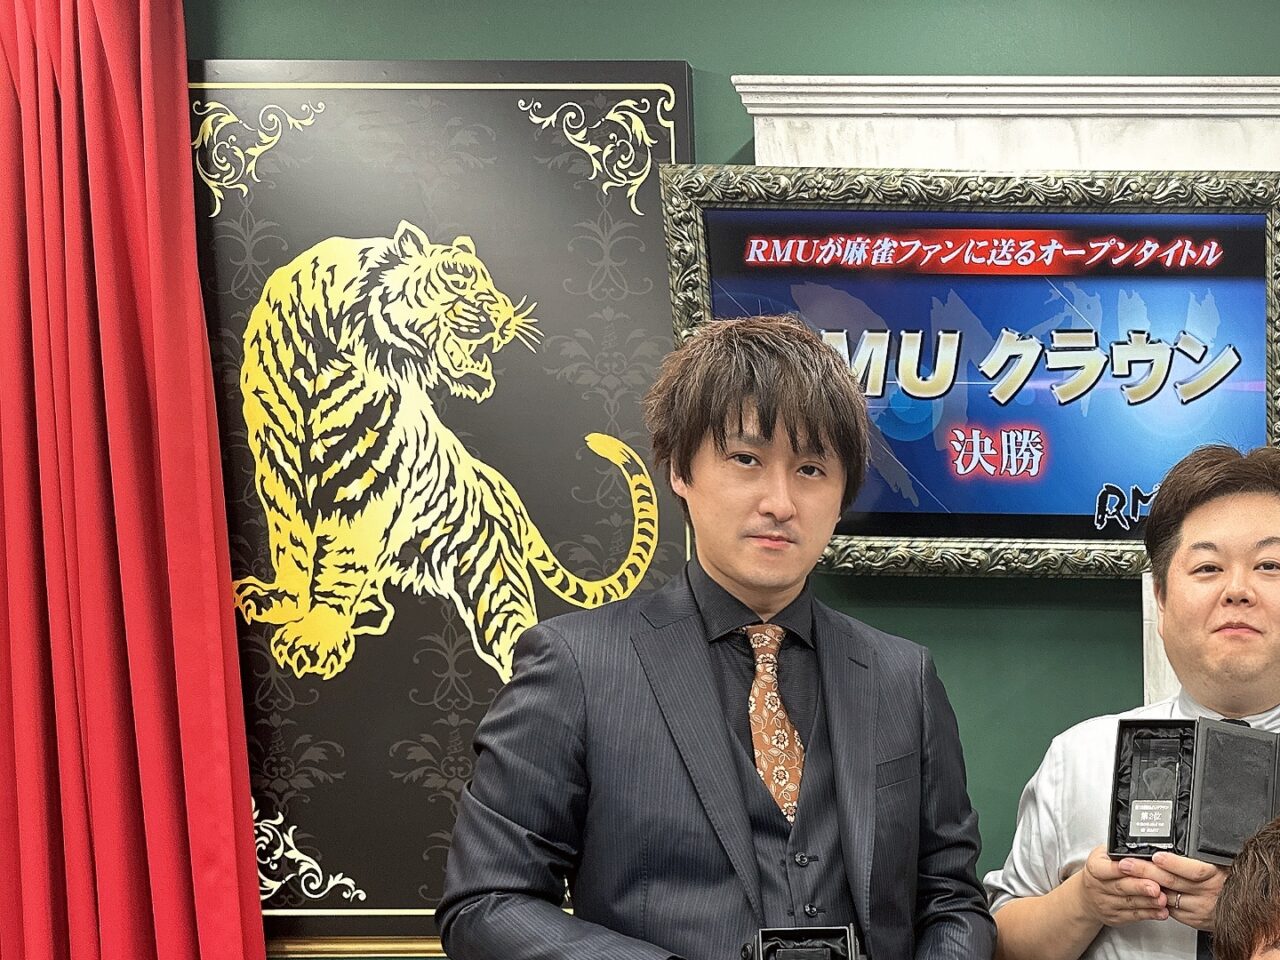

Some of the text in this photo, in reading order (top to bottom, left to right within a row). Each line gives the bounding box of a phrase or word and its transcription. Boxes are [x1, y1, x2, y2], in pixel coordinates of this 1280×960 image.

[745, 235, 1224, 268] RMUが麻雀ファンに送るオープンタイトル
[821, 327, 1242, 406] MU クラウン
[951, 428, 1046, 477] 決勝
[1094, 482, 1162, 531] RM
